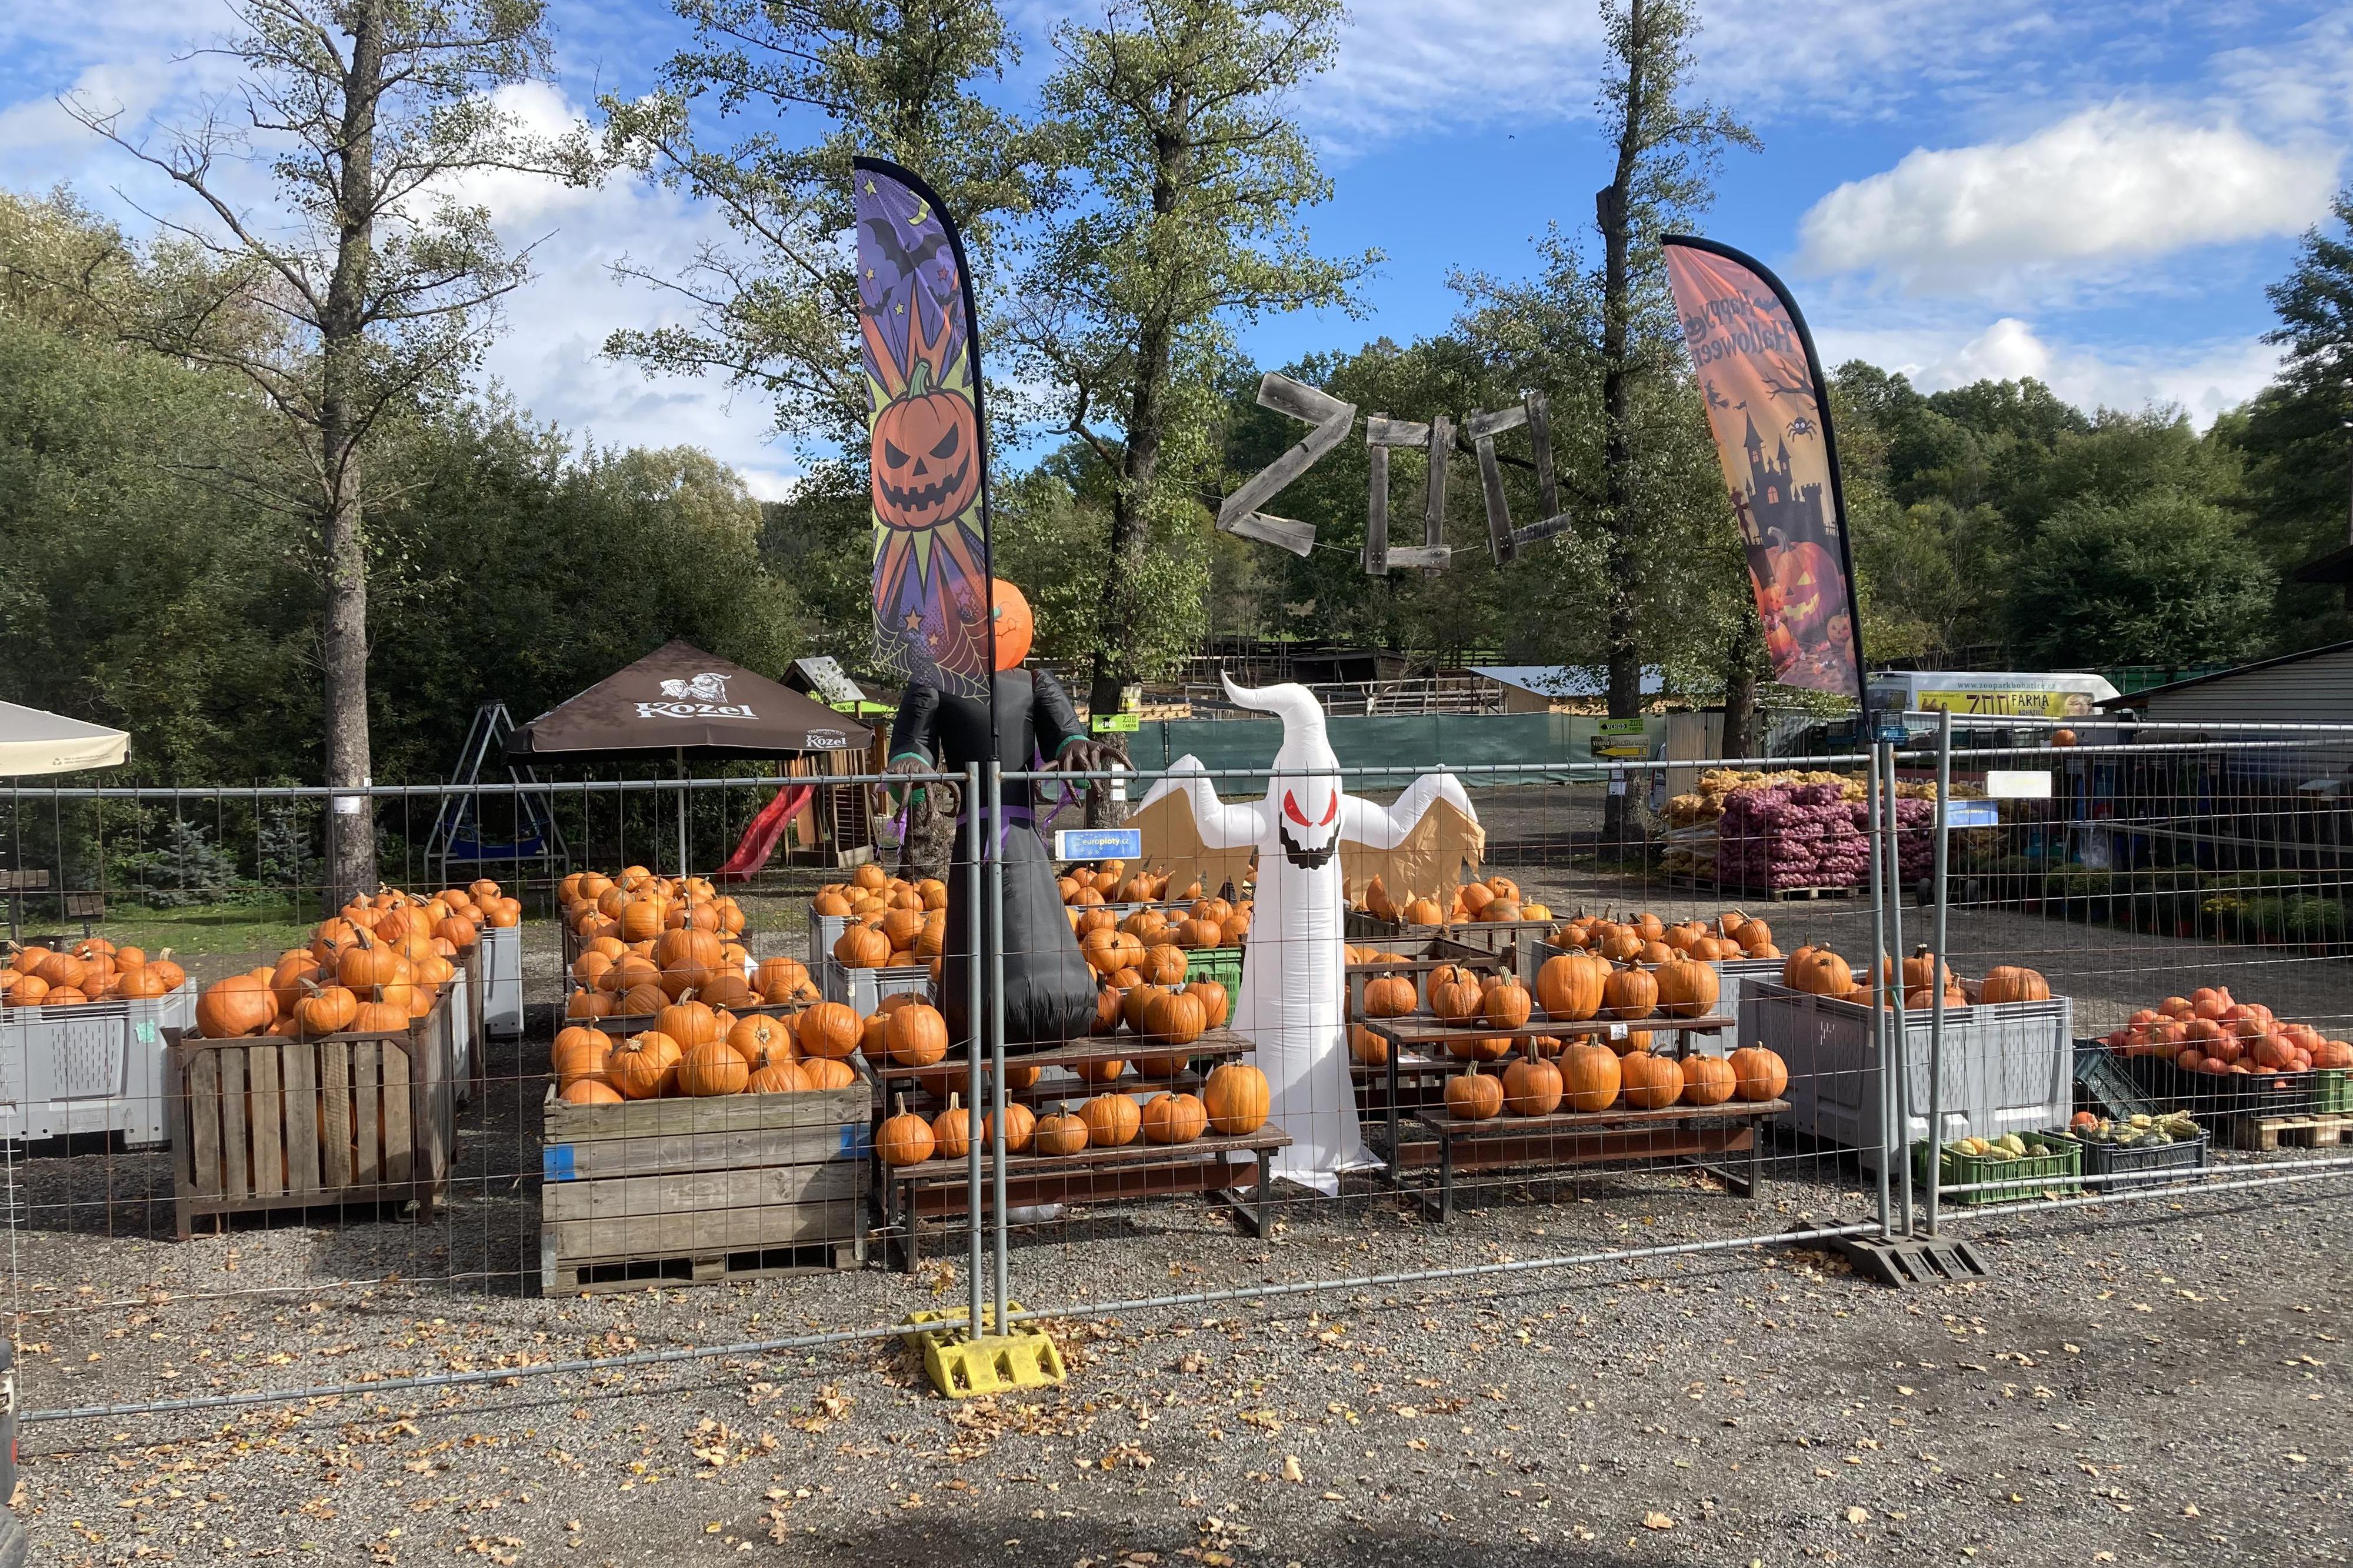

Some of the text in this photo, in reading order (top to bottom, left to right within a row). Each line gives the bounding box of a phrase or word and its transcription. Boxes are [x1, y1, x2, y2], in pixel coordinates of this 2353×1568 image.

[634, 702, 759, 719] Kozel
[1967, 693, 2049, 715] ZOO FARMA
[806, 735, 847, 748] Kozel
[1082, 837, 1129, 846] europloty.cz
